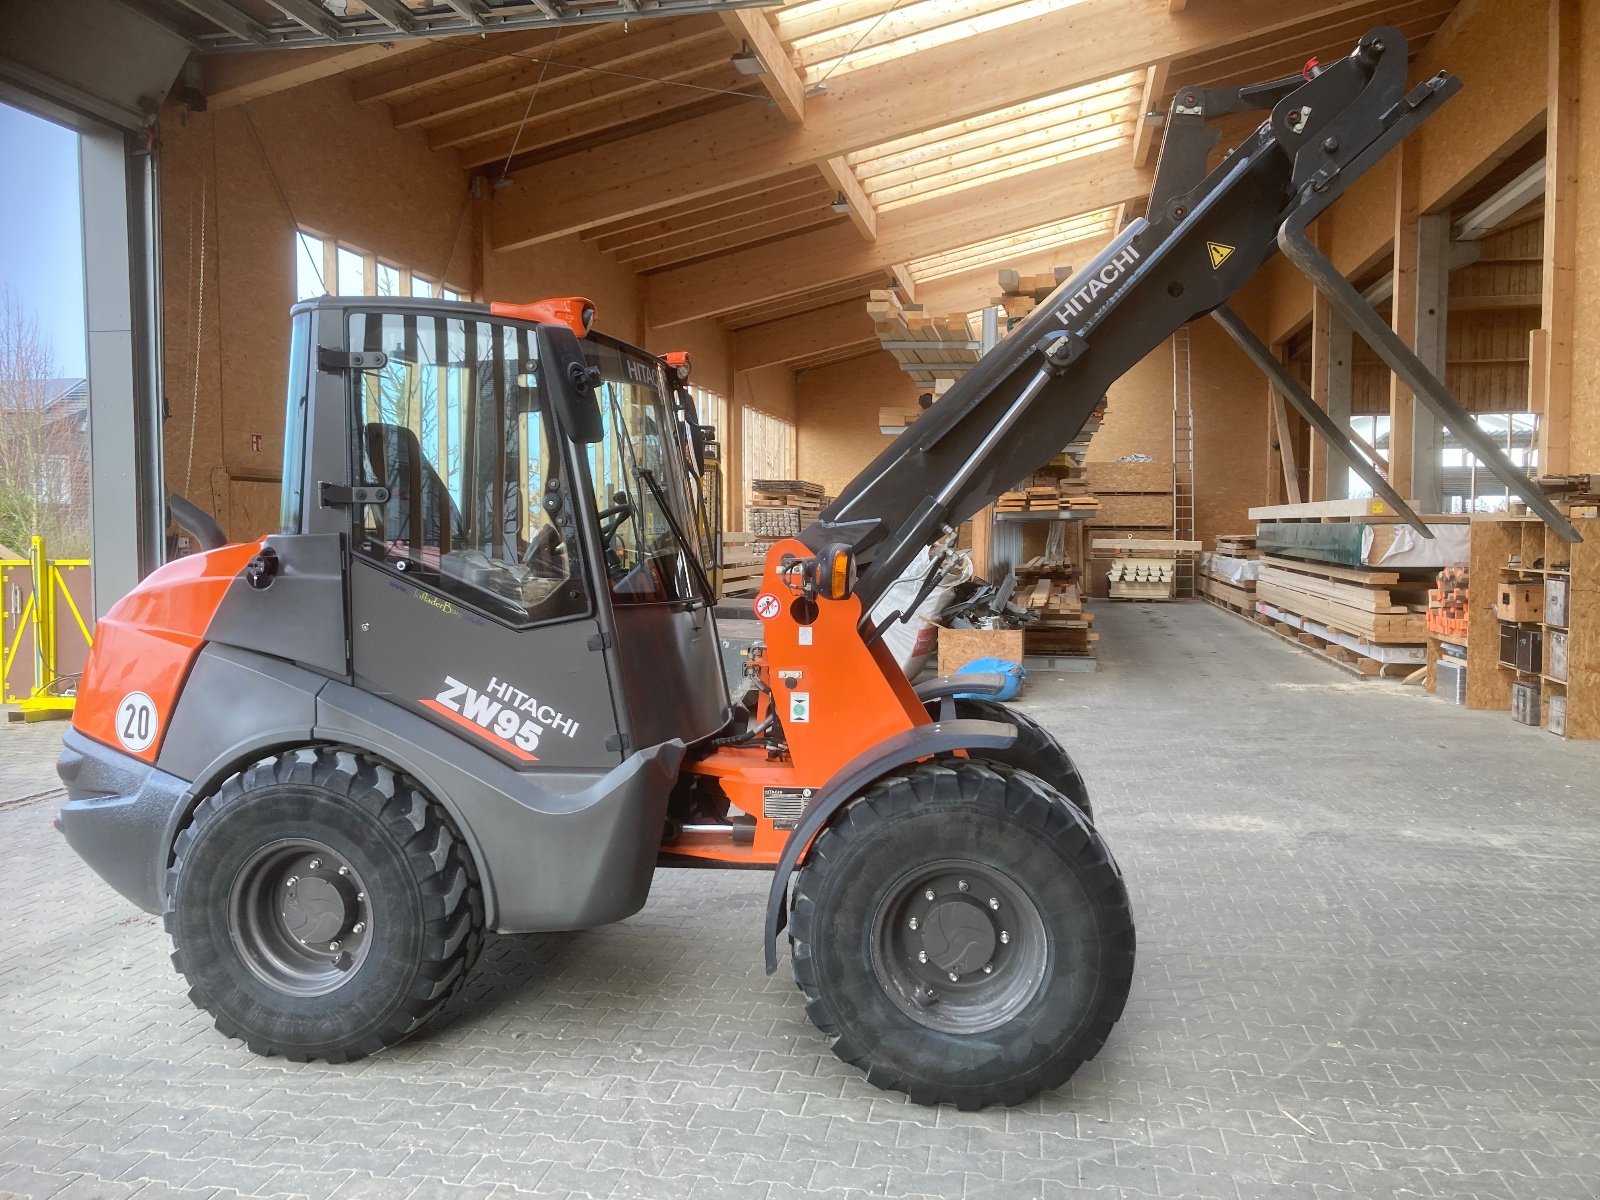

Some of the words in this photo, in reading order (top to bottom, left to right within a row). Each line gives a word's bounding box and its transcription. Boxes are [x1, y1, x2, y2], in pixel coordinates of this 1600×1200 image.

[1055, 245, 1140, 325] HITACHI
[627, 360, 660, 388] HITAC
[124, 703, 149, 740] 20
[435, 675, 543, 751] ZW95
[486, 676, 579, 738] HITACHI
